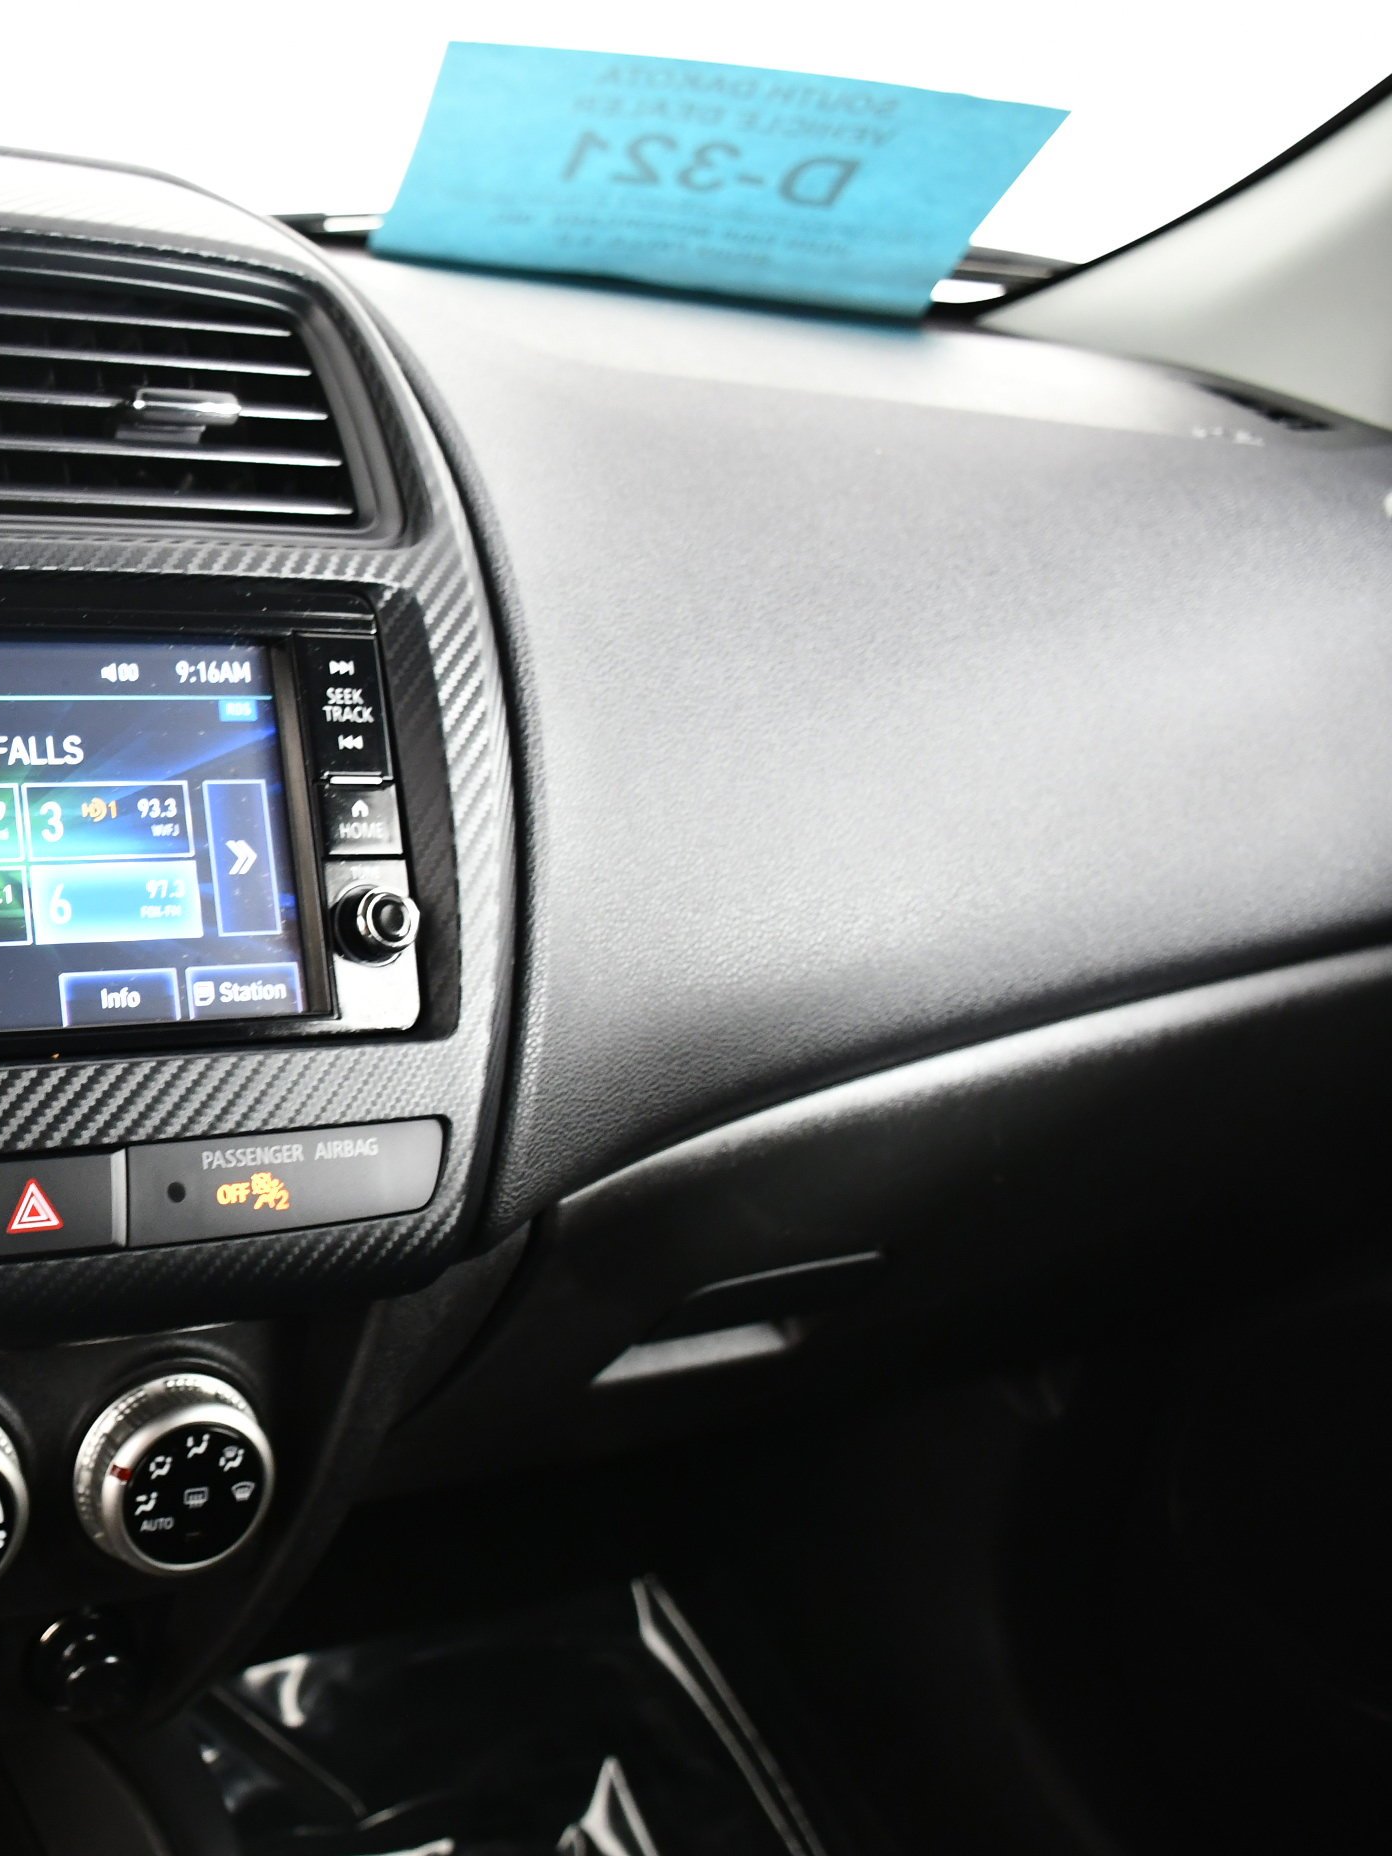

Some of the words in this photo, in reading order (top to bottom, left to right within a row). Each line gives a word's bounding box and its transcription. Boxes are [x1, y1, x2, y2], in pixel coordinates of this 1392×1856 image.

[175, 661, 251, 684] 9:16AM
[326, 687, 364, 706] SEEK
[322, 705, 375, 724] TRACK
[137, 797, 177, 818] 93.3
[39, 801, 64, 842] 3
[340, 822, 384, 840] HOME
[50, 884, 72, 924] 6
[100, 987, 141, 1009] Info
[219, 980, 287, 1002] Station
[202, 1144, 304, 1170] PASSENGER
[314, 1137, 379, 1160] AIRBAG
[216, 1182, 250, 1205] OFF
[140, 1517, 174, 1532] AUTO
